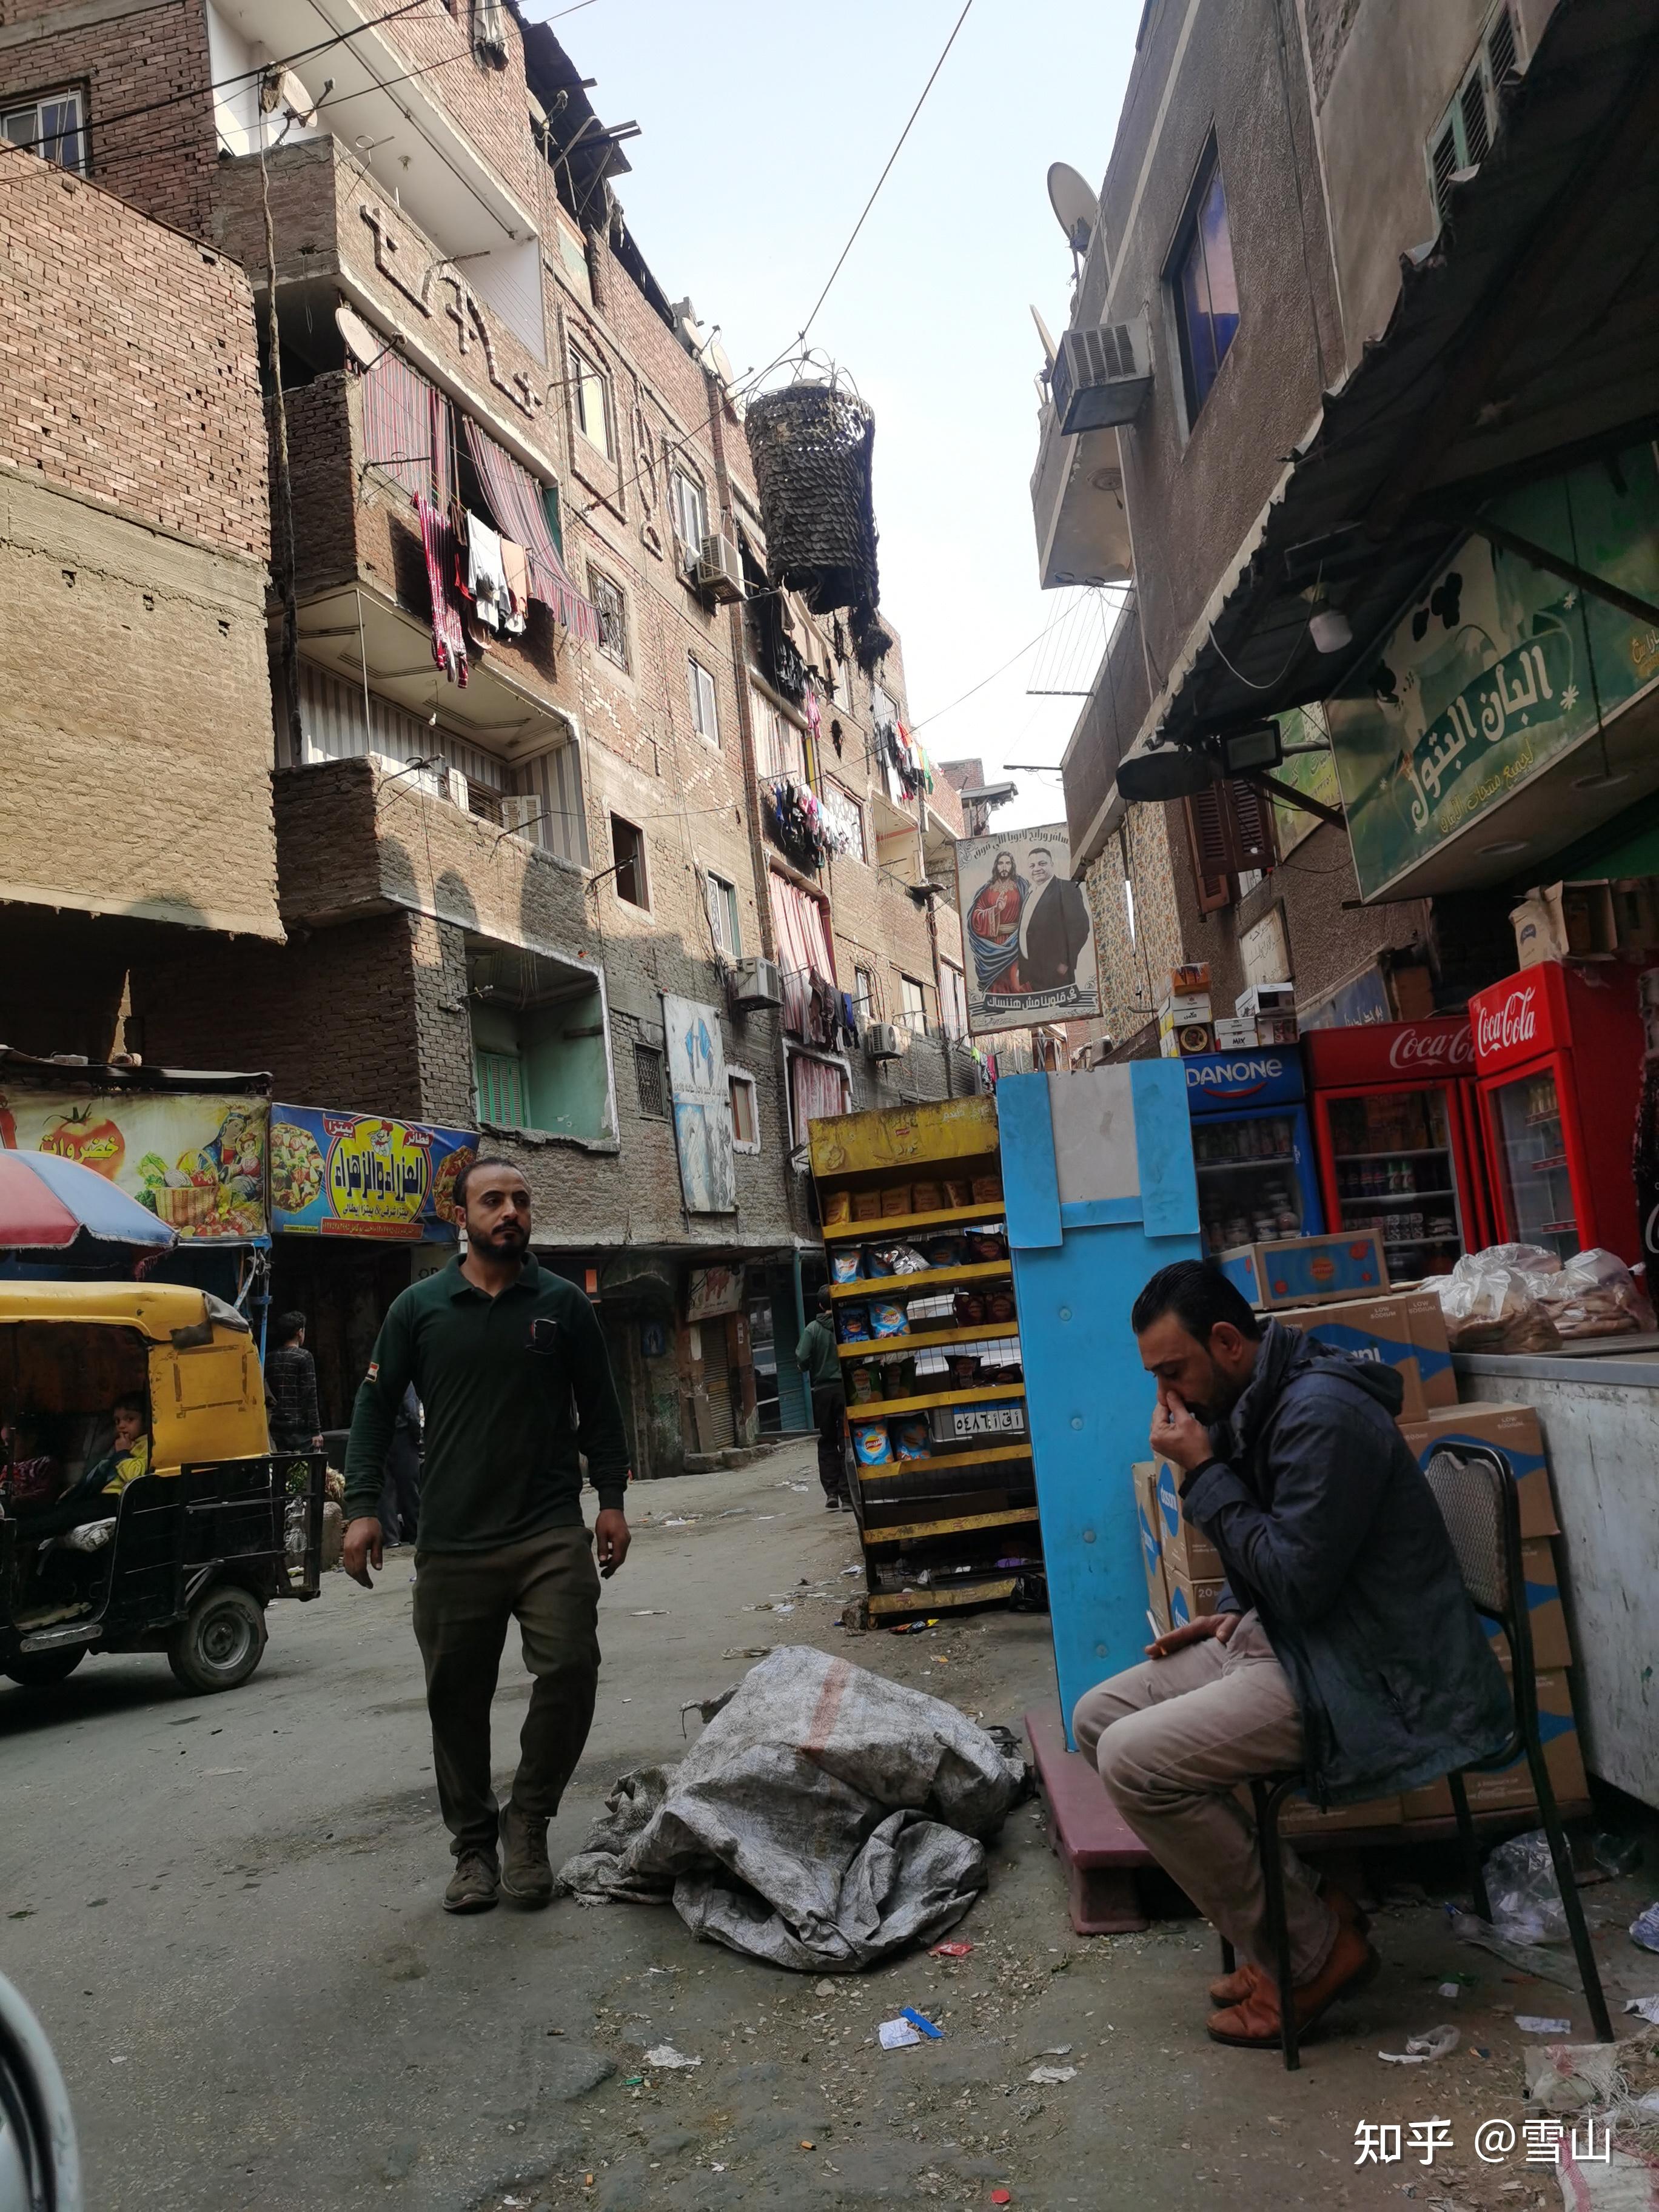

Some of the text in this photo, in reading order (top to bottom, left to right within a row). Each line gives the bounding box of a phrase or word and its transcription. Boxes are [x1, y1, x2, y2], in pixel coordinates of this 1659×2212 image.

[1411, 696, 1477, 828] البتول
[974, 841, 991, 860] فوق
[987, 996, 1022, 1009] هننساك
[1022, 996, 1040, 1010] مش
[1041, 991, 1067, 1008] قلوبنا
[1478, 986, 1536, 1057] Coca-Cola
[1389, 1024, 1475, 1068] Coca-C
[329, 1121, 354, 1138] بيتزا
[406, 1132, 429, 1145] فطائر
[39, 1134, 119, 1164] خضروات
